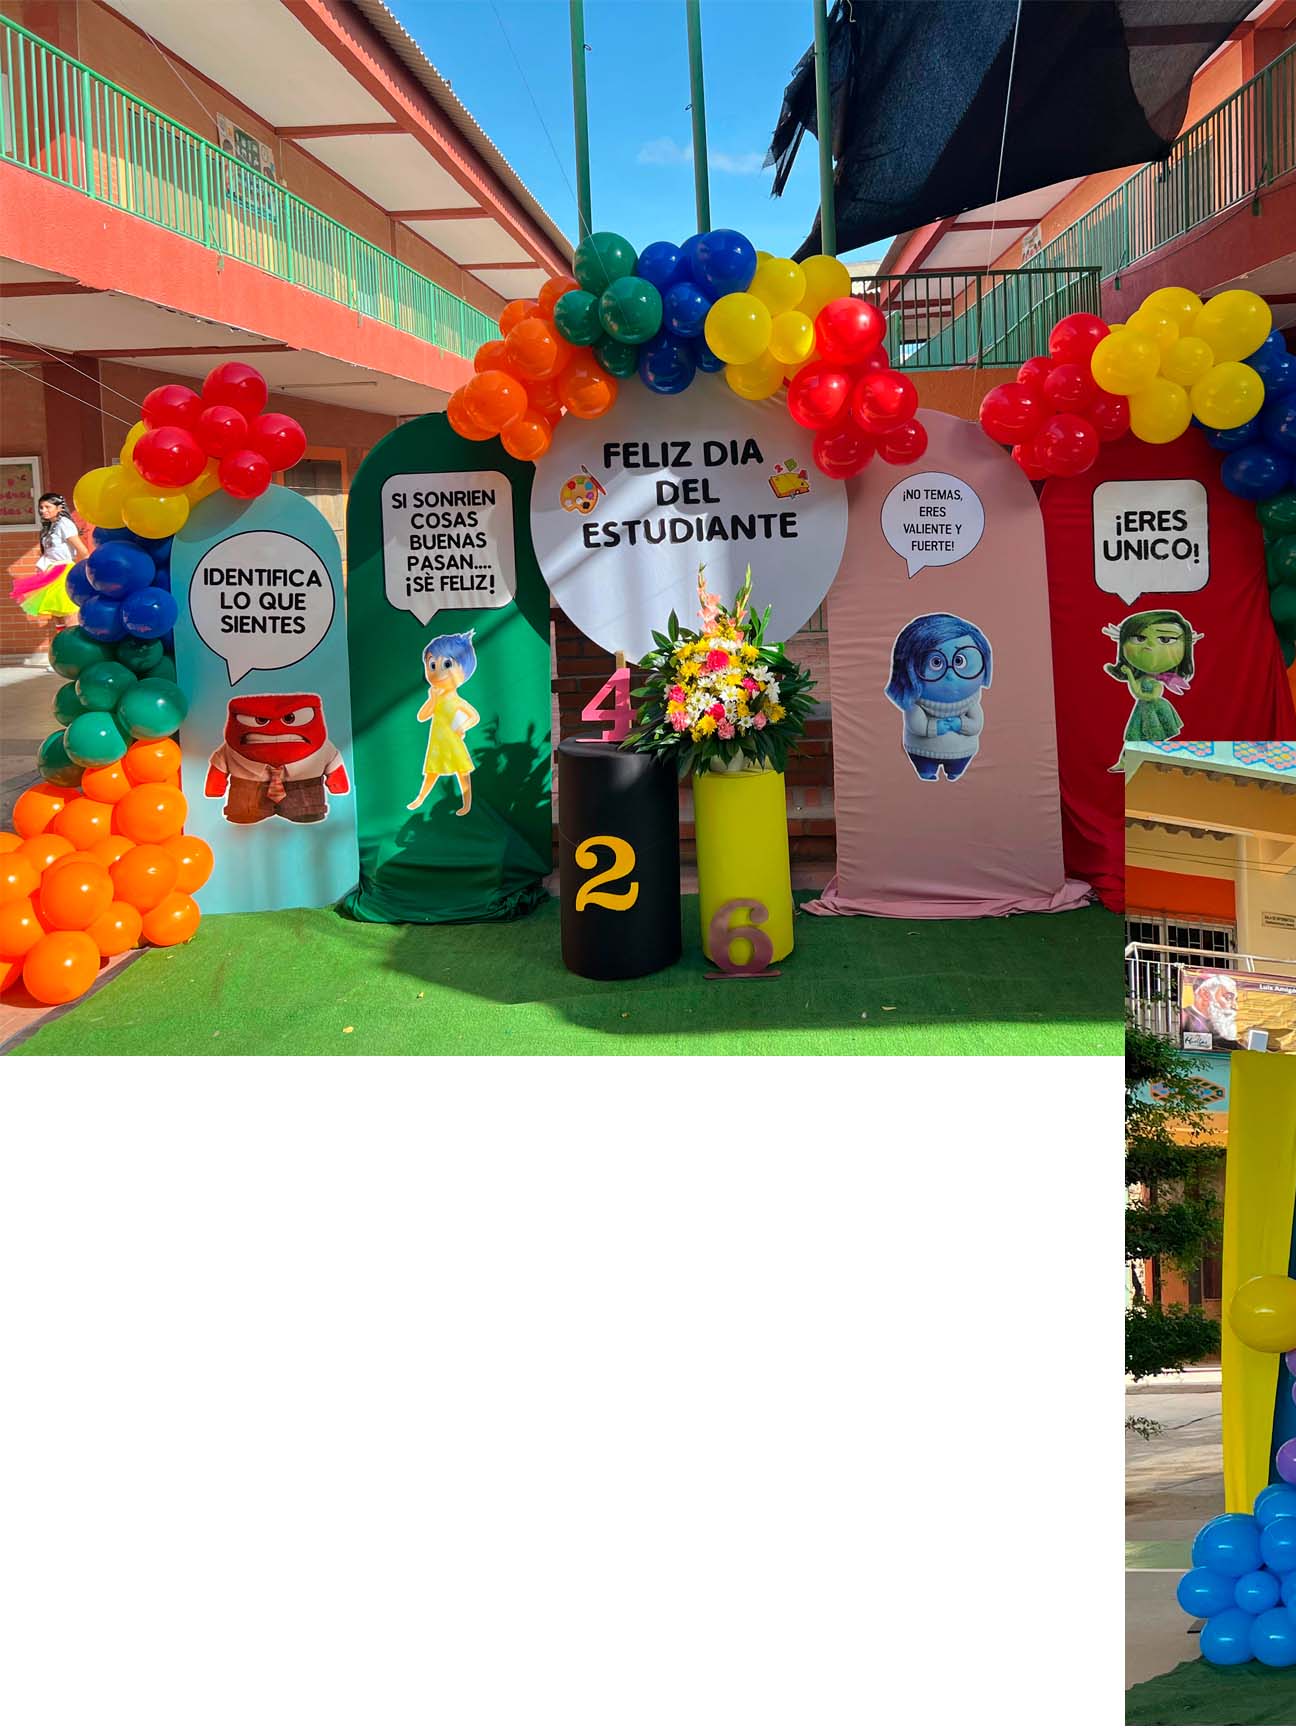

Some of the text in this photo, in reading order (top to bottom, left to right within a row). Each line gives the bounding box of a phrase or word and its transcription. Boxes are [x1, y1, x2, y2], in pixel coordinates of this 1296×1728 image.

[603, 438, 764, 468] FELIZ DIA
[391, 489, 496, 509] SI SONRIEN
[656, 478, 720, 506] DEL
[903, 489, 963, 502] ¡NO TEMAS,
[410, 511, 479, 529] COSAS
[919, 506, 947, 518] ERES
[582, 512, 799, 548] ESTUDIANTE
[903, 523, 962, 535] VALIENTE Y
[1115, 509, 1188, 536] ¡ERES
[409, 532, 487, 550] BUENAS
[911, 540, 955, 552] FUERTE!
[1103, 537, 1200, 564] UNICO!
[203, 568, 323, 588] IDENTIFICA
[440, 574, 496, 595] FELIZ!
[220, 591, 307, 611] LO QUE
[220, 615, 306, 635] SIENTES
[581, 667, 638, 742] 4
[574, 835, 640, 912] 2
[709, 897, 774, 975] 6
[1259, 983, 1274, 991] Luis
